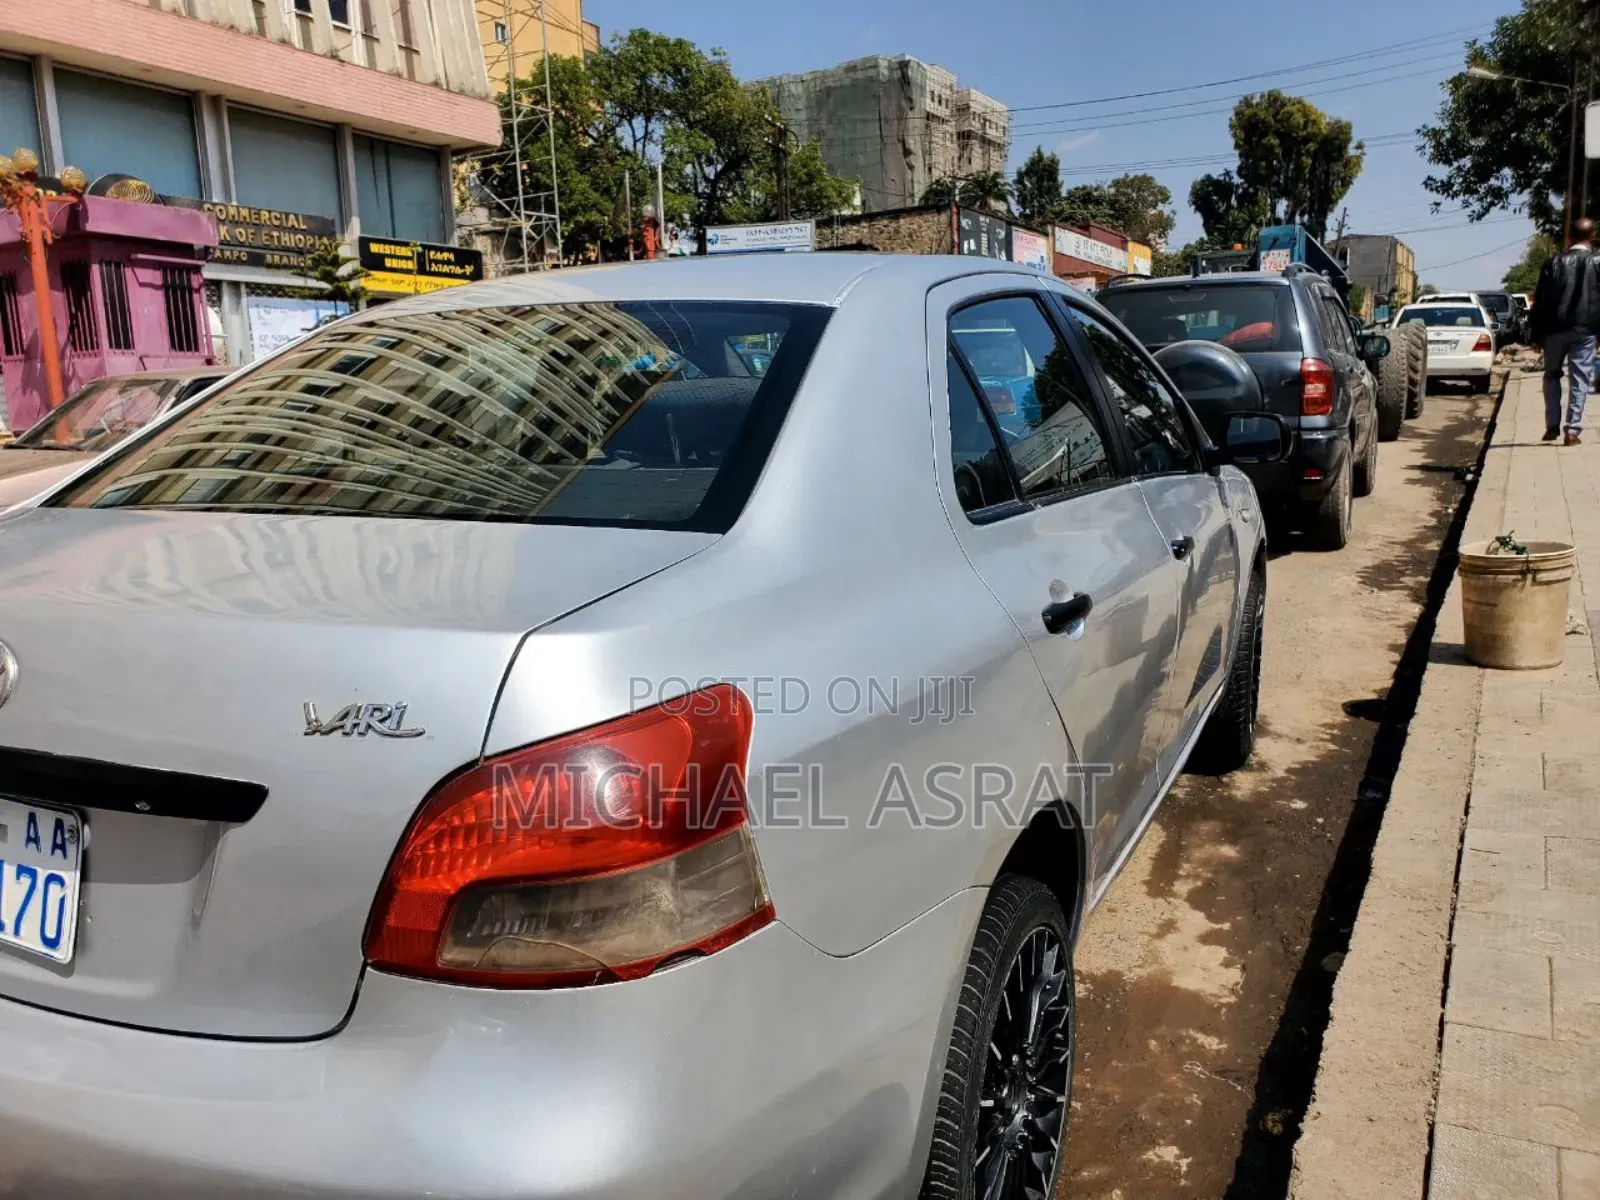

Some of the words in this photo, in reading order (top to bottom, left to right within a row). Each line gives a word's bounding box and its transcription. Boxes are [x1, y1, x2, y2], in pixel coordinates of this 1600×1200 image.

[235, 227, 255, 244] OF
[369, 241, 413, 257] WESTERN
[384, 257, 414, 270] UNION
